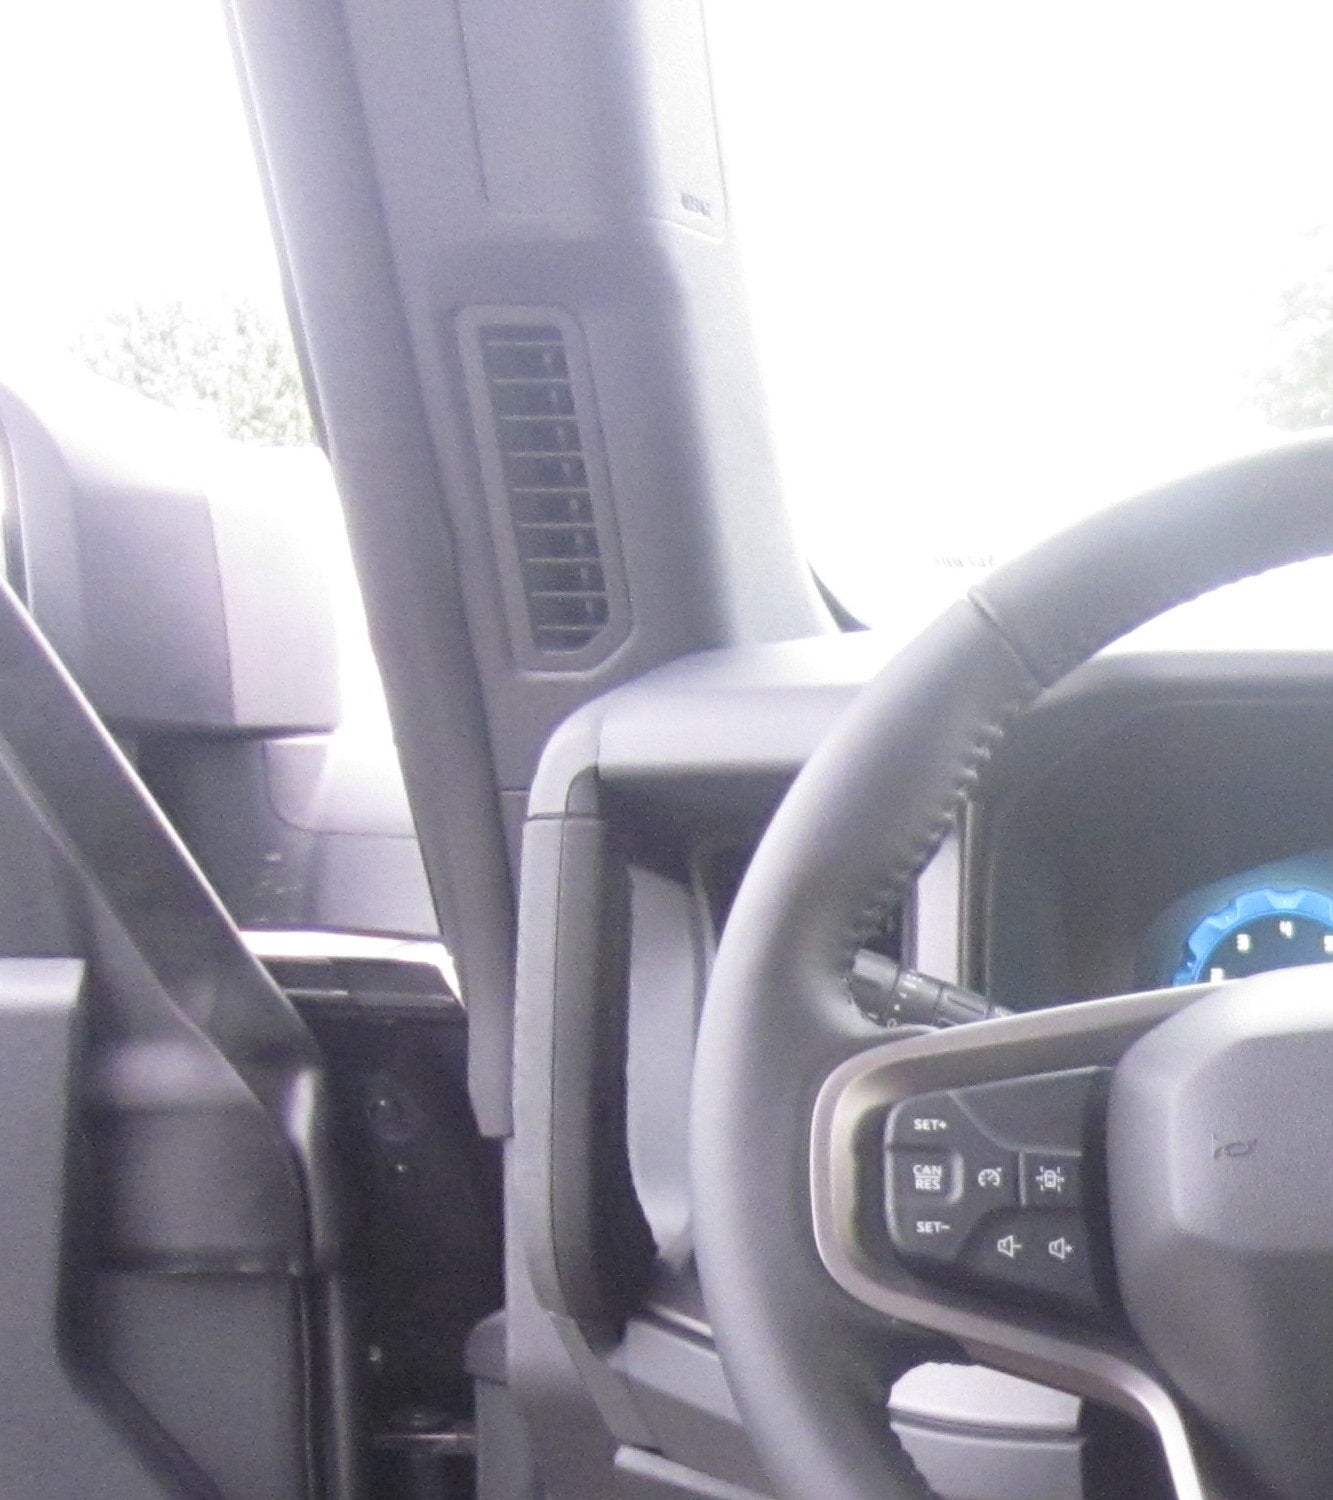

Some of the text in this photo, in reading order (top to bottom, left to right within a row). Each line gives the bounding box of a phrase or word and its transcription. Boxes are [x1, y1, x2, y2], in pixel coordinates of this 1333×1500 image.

[1279, 920, 1294, 940] 4
[913, 1117, 948, 1131] SET+
[912, 1164, 943, 1177] CAN
[914, 1178, 942, 1191] RES
